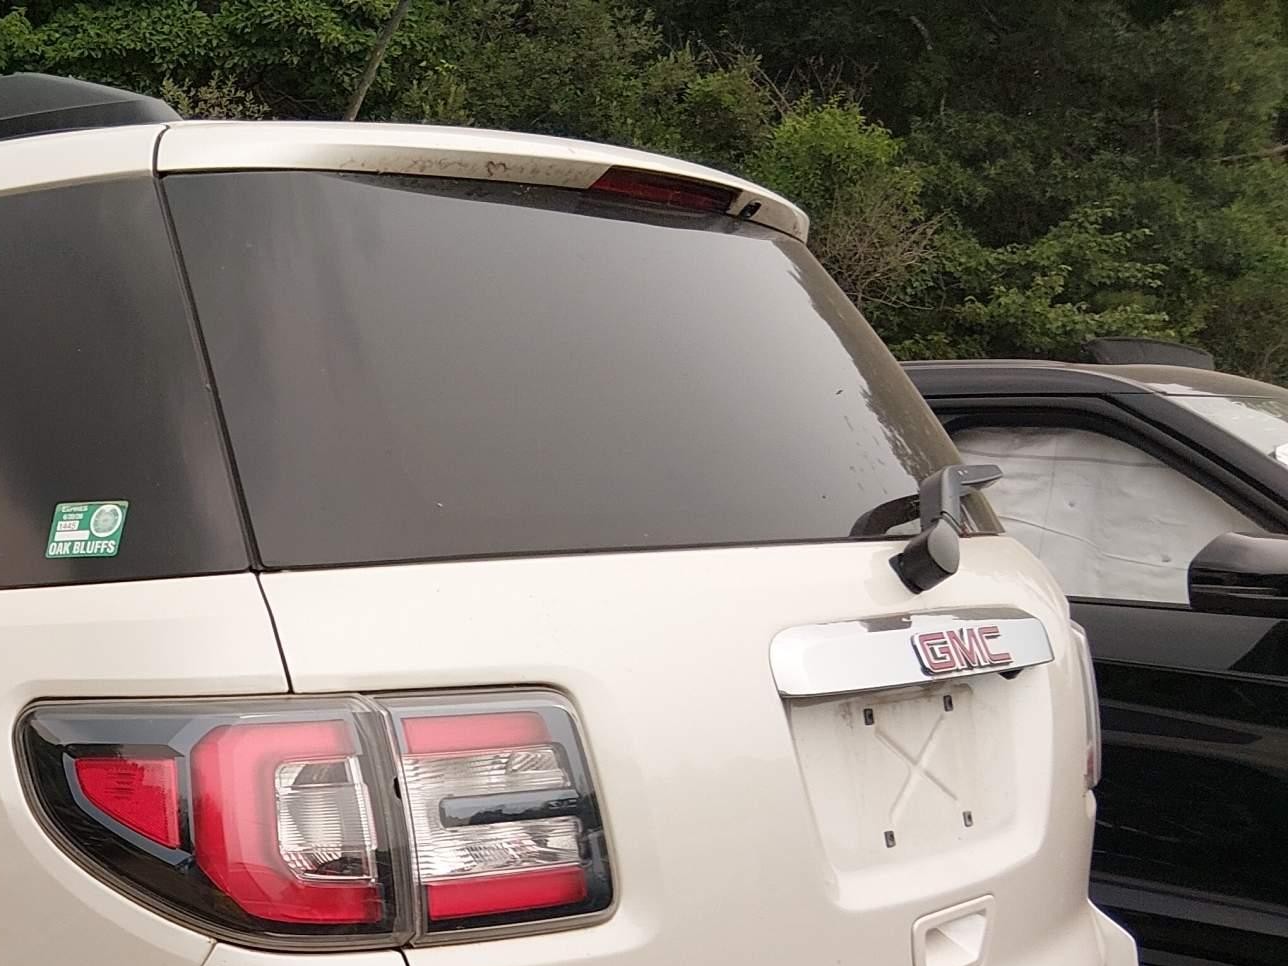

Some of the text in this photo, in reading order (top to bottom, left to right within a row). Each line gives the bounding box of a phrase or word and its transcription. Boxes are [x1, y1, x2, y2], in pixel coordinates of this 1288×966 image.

[49, 541, 116, 555] OAK BLUFFS
[913, 626, 1013, 676] GMC
